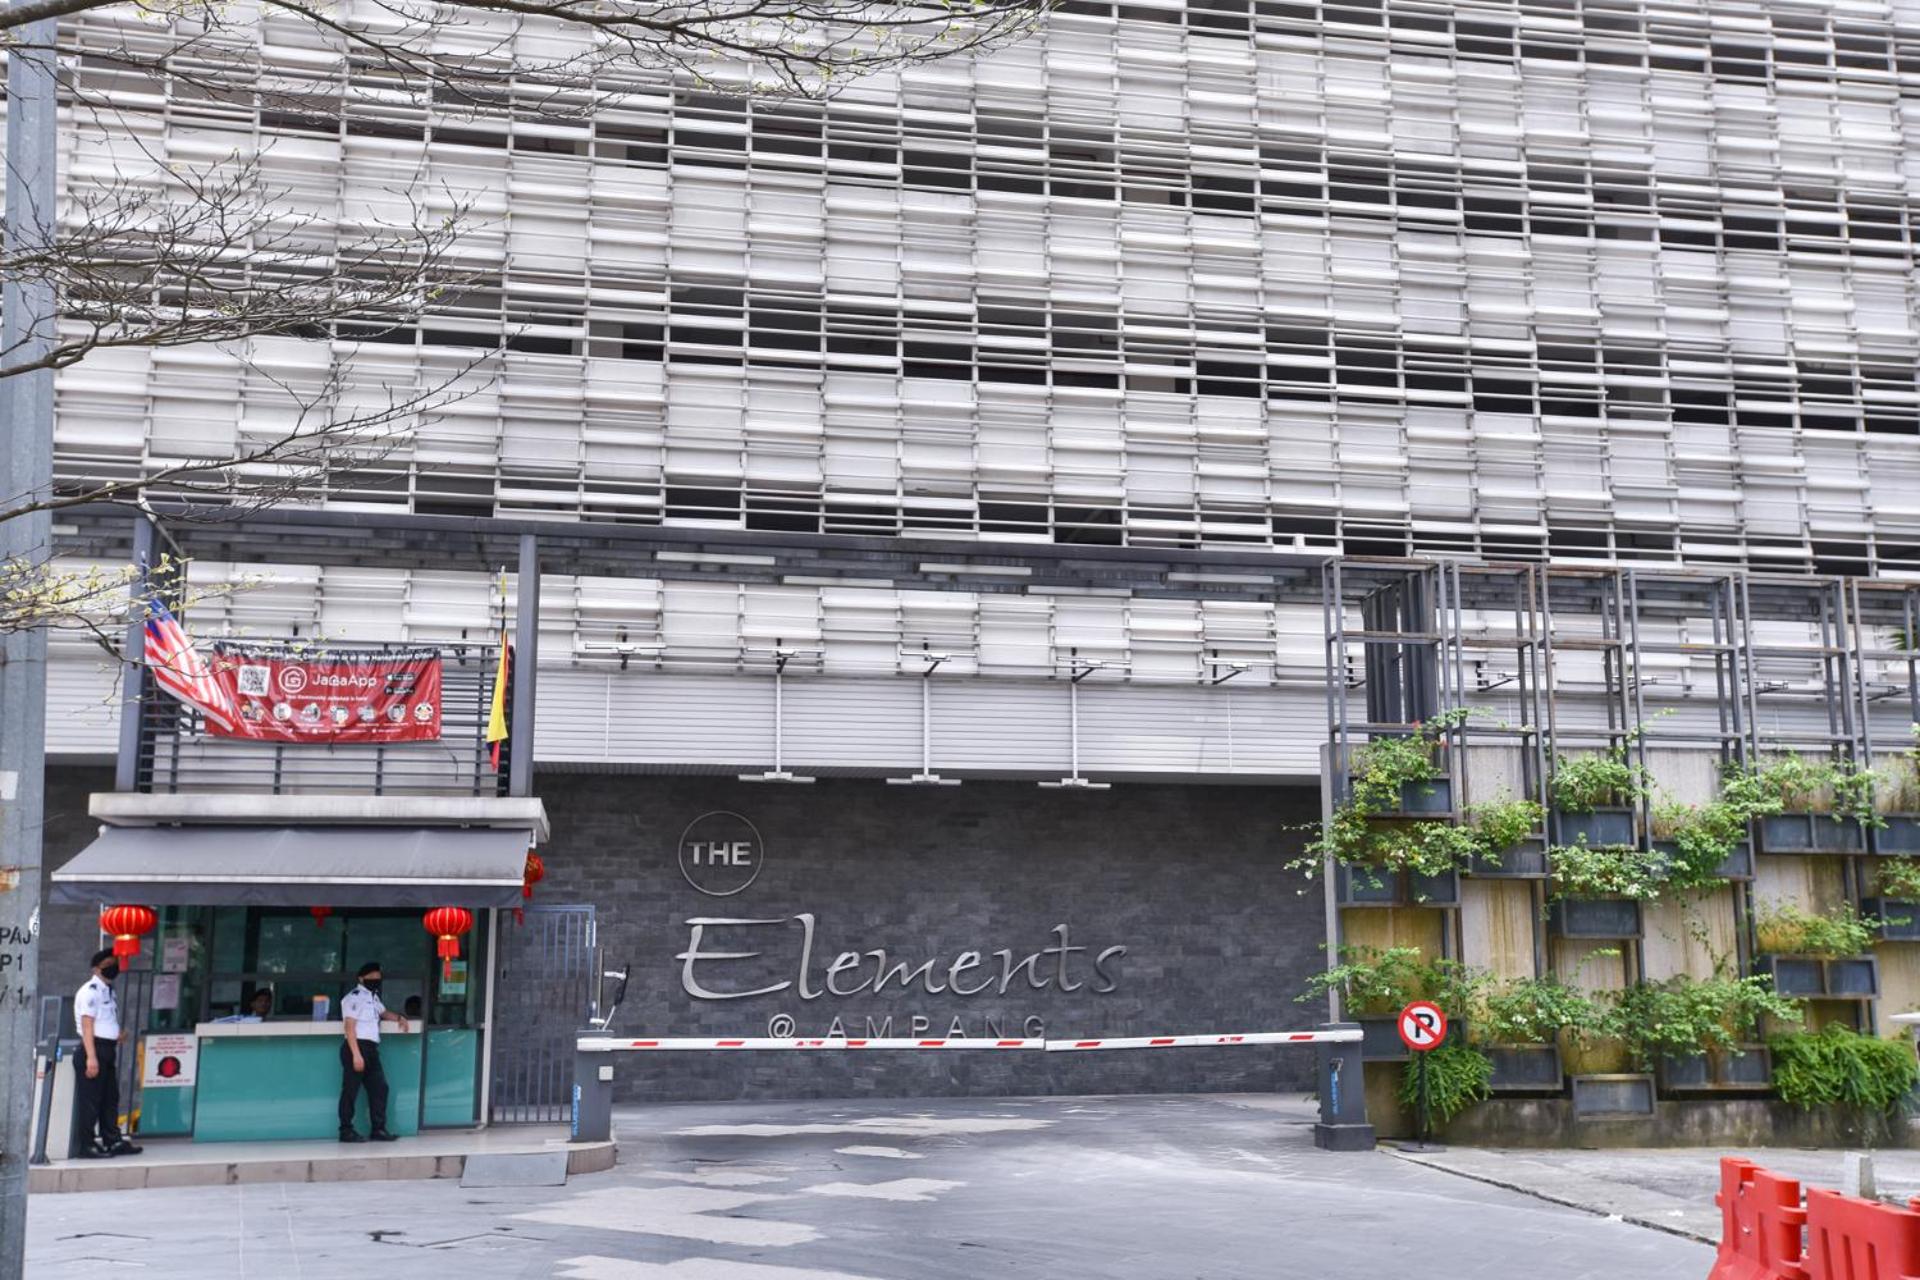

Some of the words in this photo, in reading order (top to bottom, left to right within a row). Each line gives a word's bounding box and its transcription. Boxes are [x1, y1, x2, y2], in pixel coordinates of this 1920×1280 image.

[687, 841, 751, 866] THE
[675, 912, 1128, 1000] Elements
[767, 1013, 796, 1039] @
[826, 1014, 1046, 1039] AMPANG
